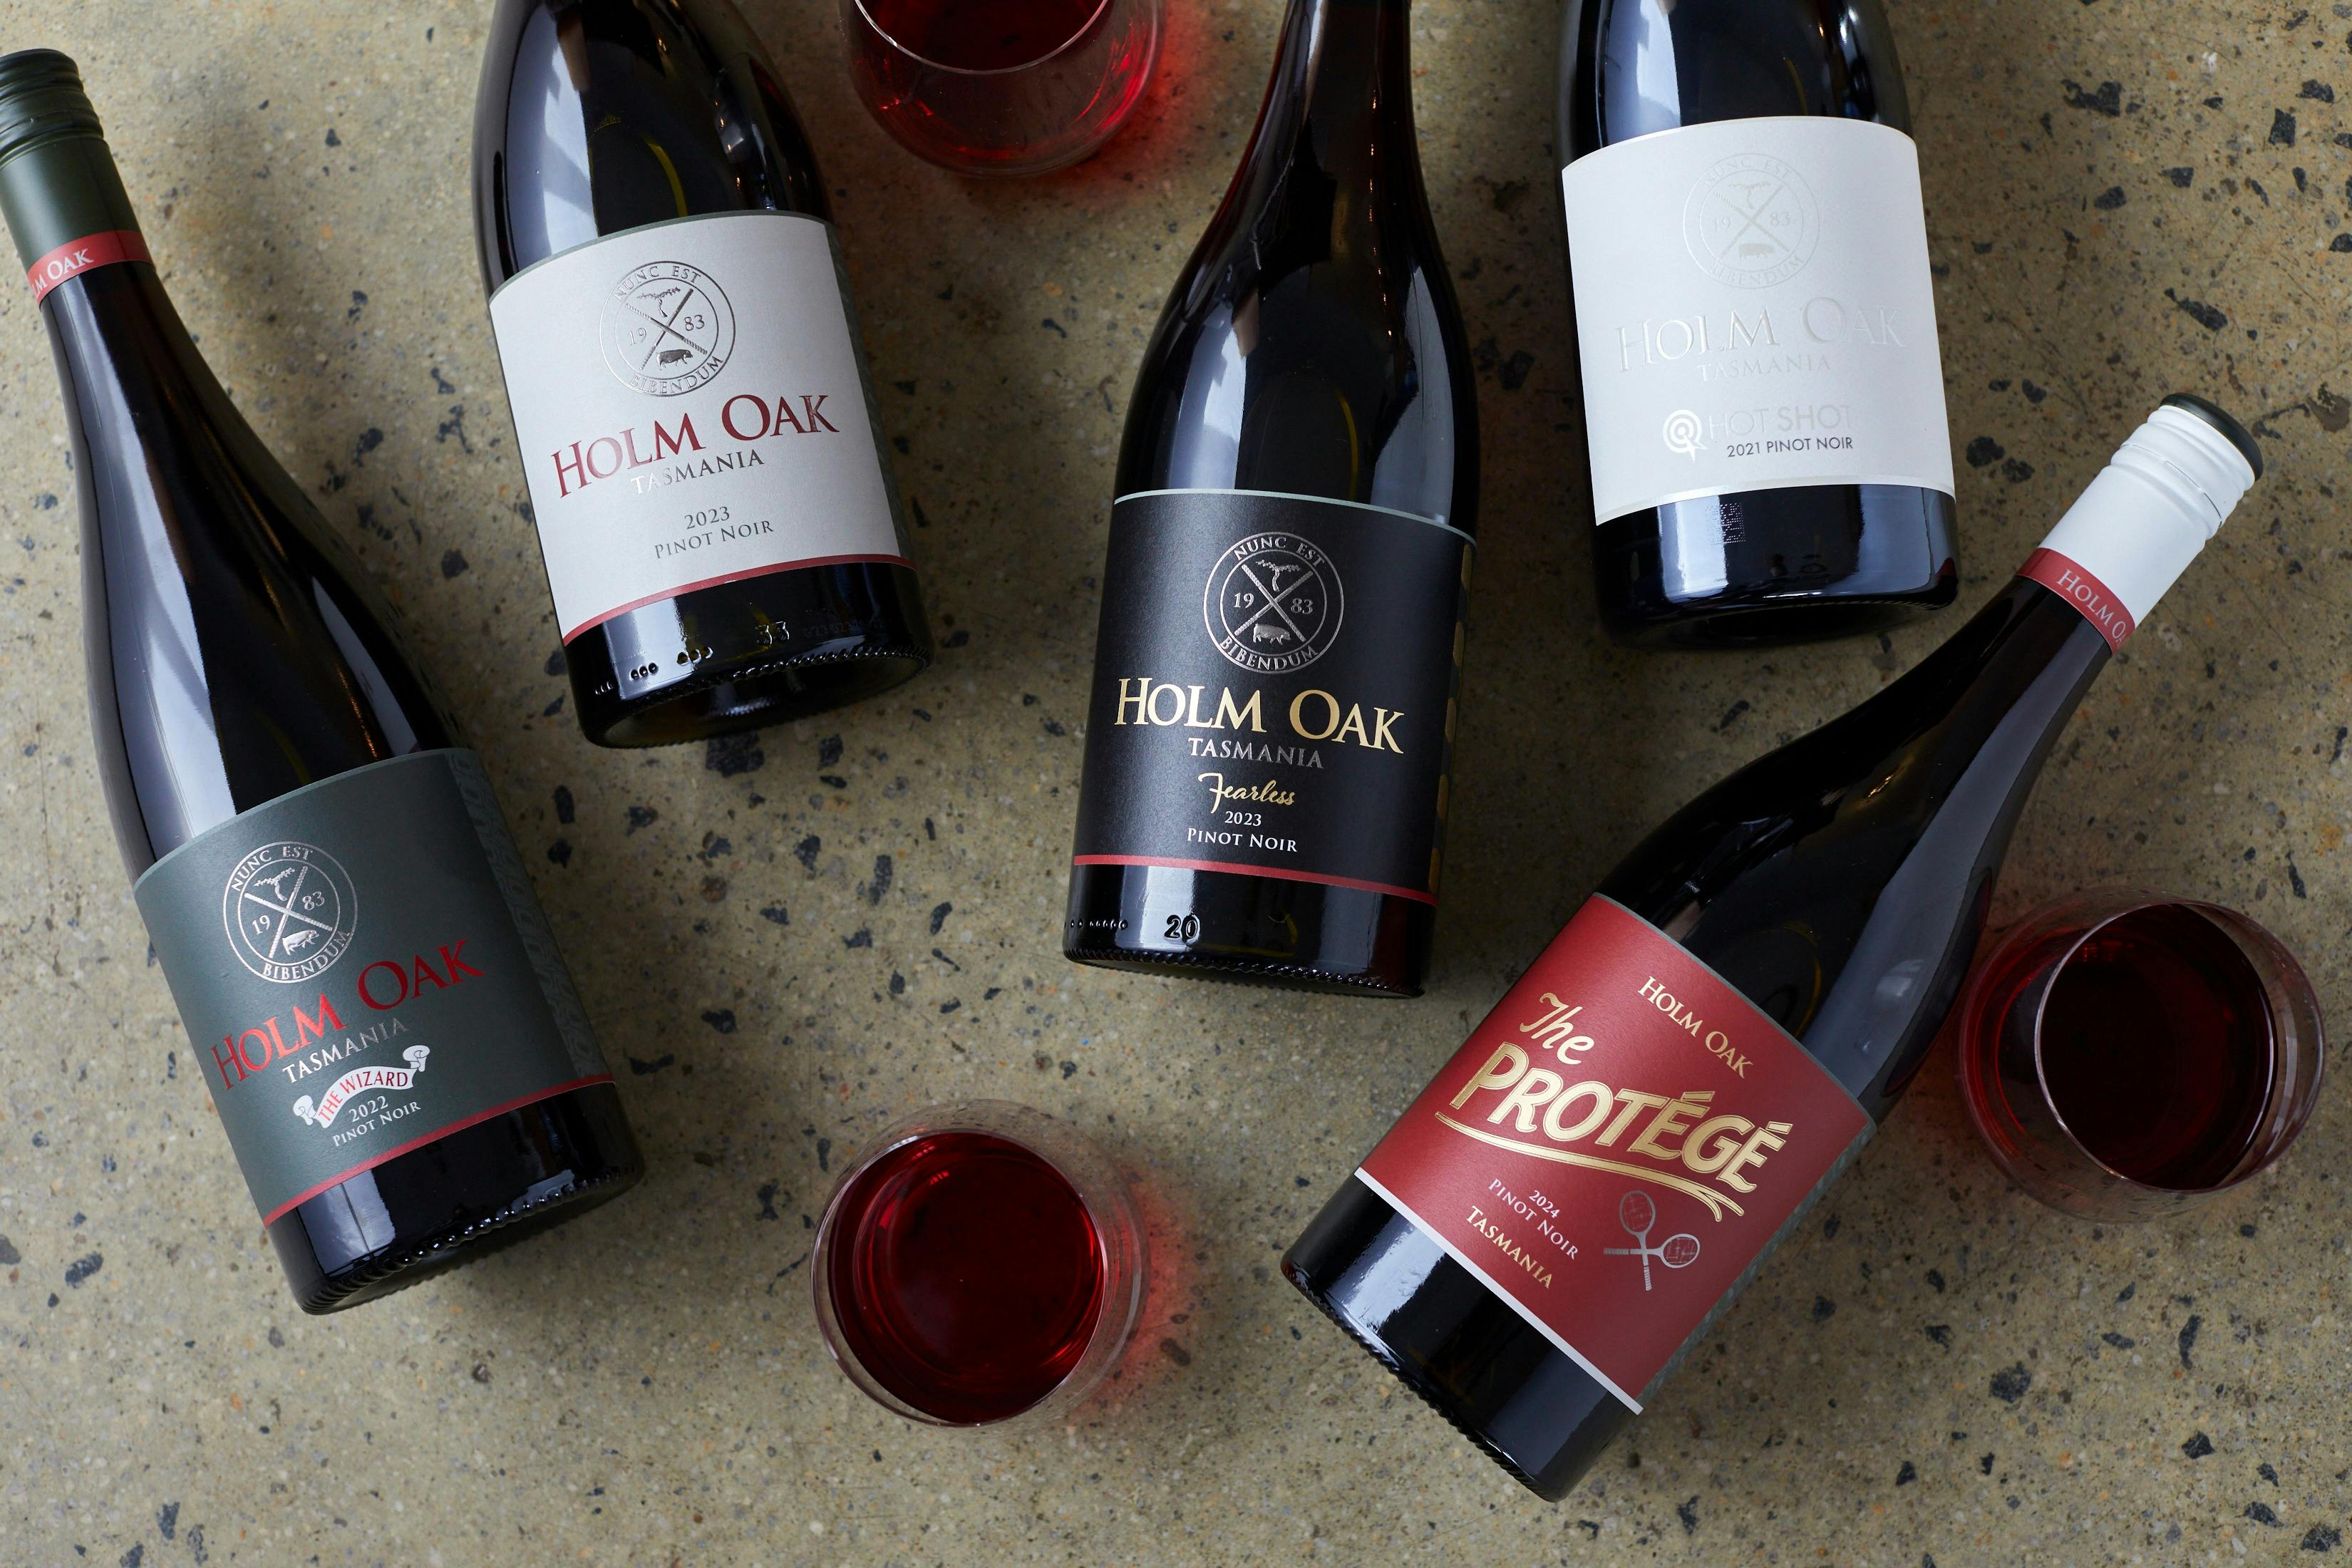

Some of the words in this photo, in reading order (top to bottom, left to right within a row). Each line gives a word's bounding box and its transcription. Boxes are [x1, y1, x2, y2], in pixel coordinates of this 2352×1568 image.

[1769, 211, 1790, 227] 83
[47, 248, 94, 280] OAK
[613, 265, 659, 302] NUNC
[672, 265, 702, 284] EST
[628, 327, 647, 346] 19
[684, 314, 705, 331] 83
[1615, 306, 1781, 373] HOLM
[1799, 296, 1908, 349] OAK
[629, 356, 724, 394] BIBENDUM
[1693, 354, 1831, 383] TASMANIA
[1708, 407, 1769, 440] HOT
[1778, 403, 1857, 433] SHOT
[550, 413, 706, 498] HOLM
[721, 394, 840, 441] OAK
[1727, 442, 1760, 458] 2021
[1766, 438, 1811, 454] PINOT
[1816, 436, 1853, 450] NOIR
[631, 449, 764, 494] TASMANIA
[684, 506, 730, 530] 2023
[654, 532, 713, 559] PINOT
[721, 520, 774, 542] NOIR
[1234, 537, 1286, 561] NUNC
[1296, 542, 1326, 567] EST
[1234, 592, 1254, 608] 19
[1291, 598, 1314, 614] 83
[2056, 569, 2115, 626] HOLM
[2112, 621, 2127, 649] OA
[1219, 636, 1319, 670] BIBENDUM
[1114, 677, 1267, 733] HOLM
[1289, 689, 1404, 754] OAK
[1188, 737, 1324, 769] TASMANIA
[1197, 773, 1296, 814] Fearless
[1224, 811, 1262, 827] 2023
[1187, 827, 1243, 846] PINOT
[1249, 833, 1298, 852] NOIR
[232, 850, 272, 892] NUNC
[282, 846, 313, 860] EST
[252, 914, 271, 935] 19
[301, 891, 325, 911] 83
[1164, 914, 1201, 946] 20
[262, 931, 350, 981] BIBENDUM
[212, 993, 349, 1091] HOLM
[356, 938, 485, 1011] OAK
[1520, 992, 1595, 1065] The
[1638, 976, 1703, 1037] HOLM
[1705, 1031, 1753, 1079] OAK
[282, 1018, 410, 1083] TASMANIA
[319, 1090, 343, 1121] THE
[339, 1071, 408, 1094] WIZARD
[349, 1095, 388, 1123] 2022
[332, 1120, 376, 1147] PINOT
[379, 1101, 421, 1125] NOIR
[1448, 1041, 1793, 1193] PROTÉGÉ
[1488, 1178, 1537, 1222] PINOT
[1537, 1219, 1579, 1260] NOIR
[1529, 1190, 1560, 1218] 2024
[1465, 1205, 1552, 1289] TASMANIA
